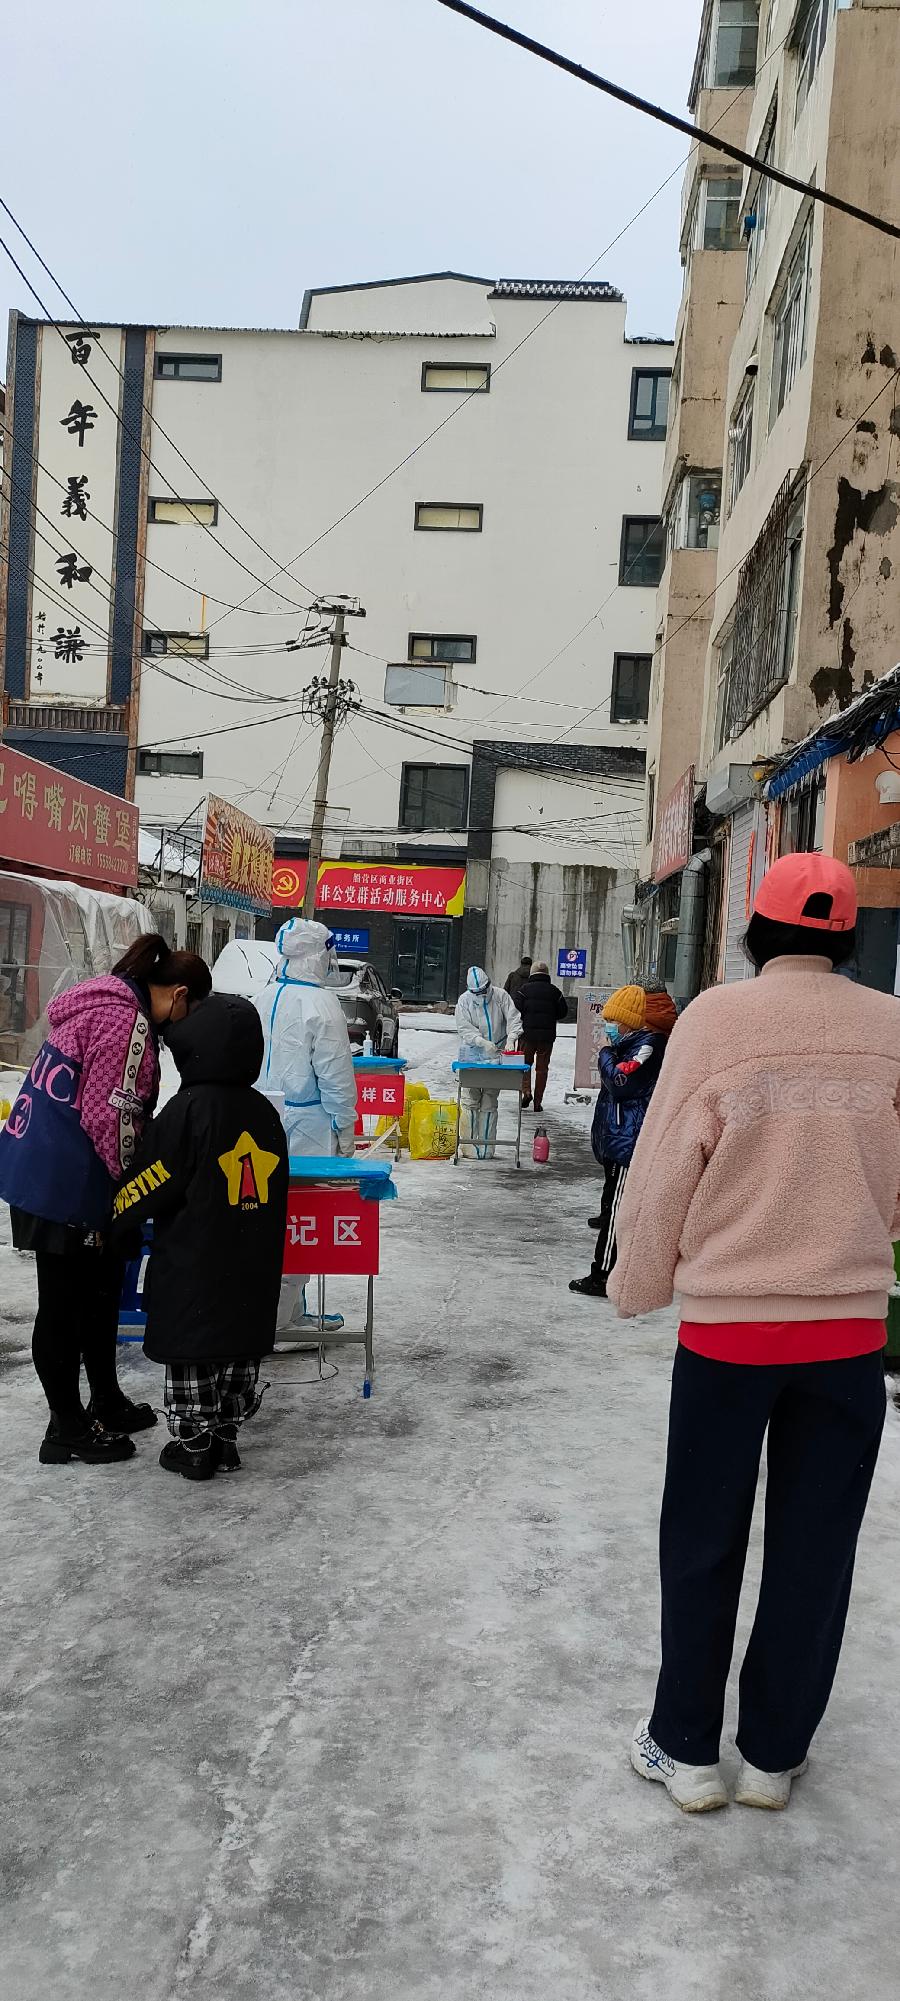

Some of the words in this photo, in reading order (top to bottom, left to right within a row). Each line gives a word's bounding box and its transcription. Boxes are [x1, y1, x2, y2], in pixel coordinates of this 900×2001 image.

[50, 331, 100, 664] 百年義和謙
[319, 884, 446, 909] 非公党群活动服务中心
[361, 1086, 397, 1104] 样区
[241, 1202, 258, 1211] 2004
[287, 1215, 363, 1246] 记区
